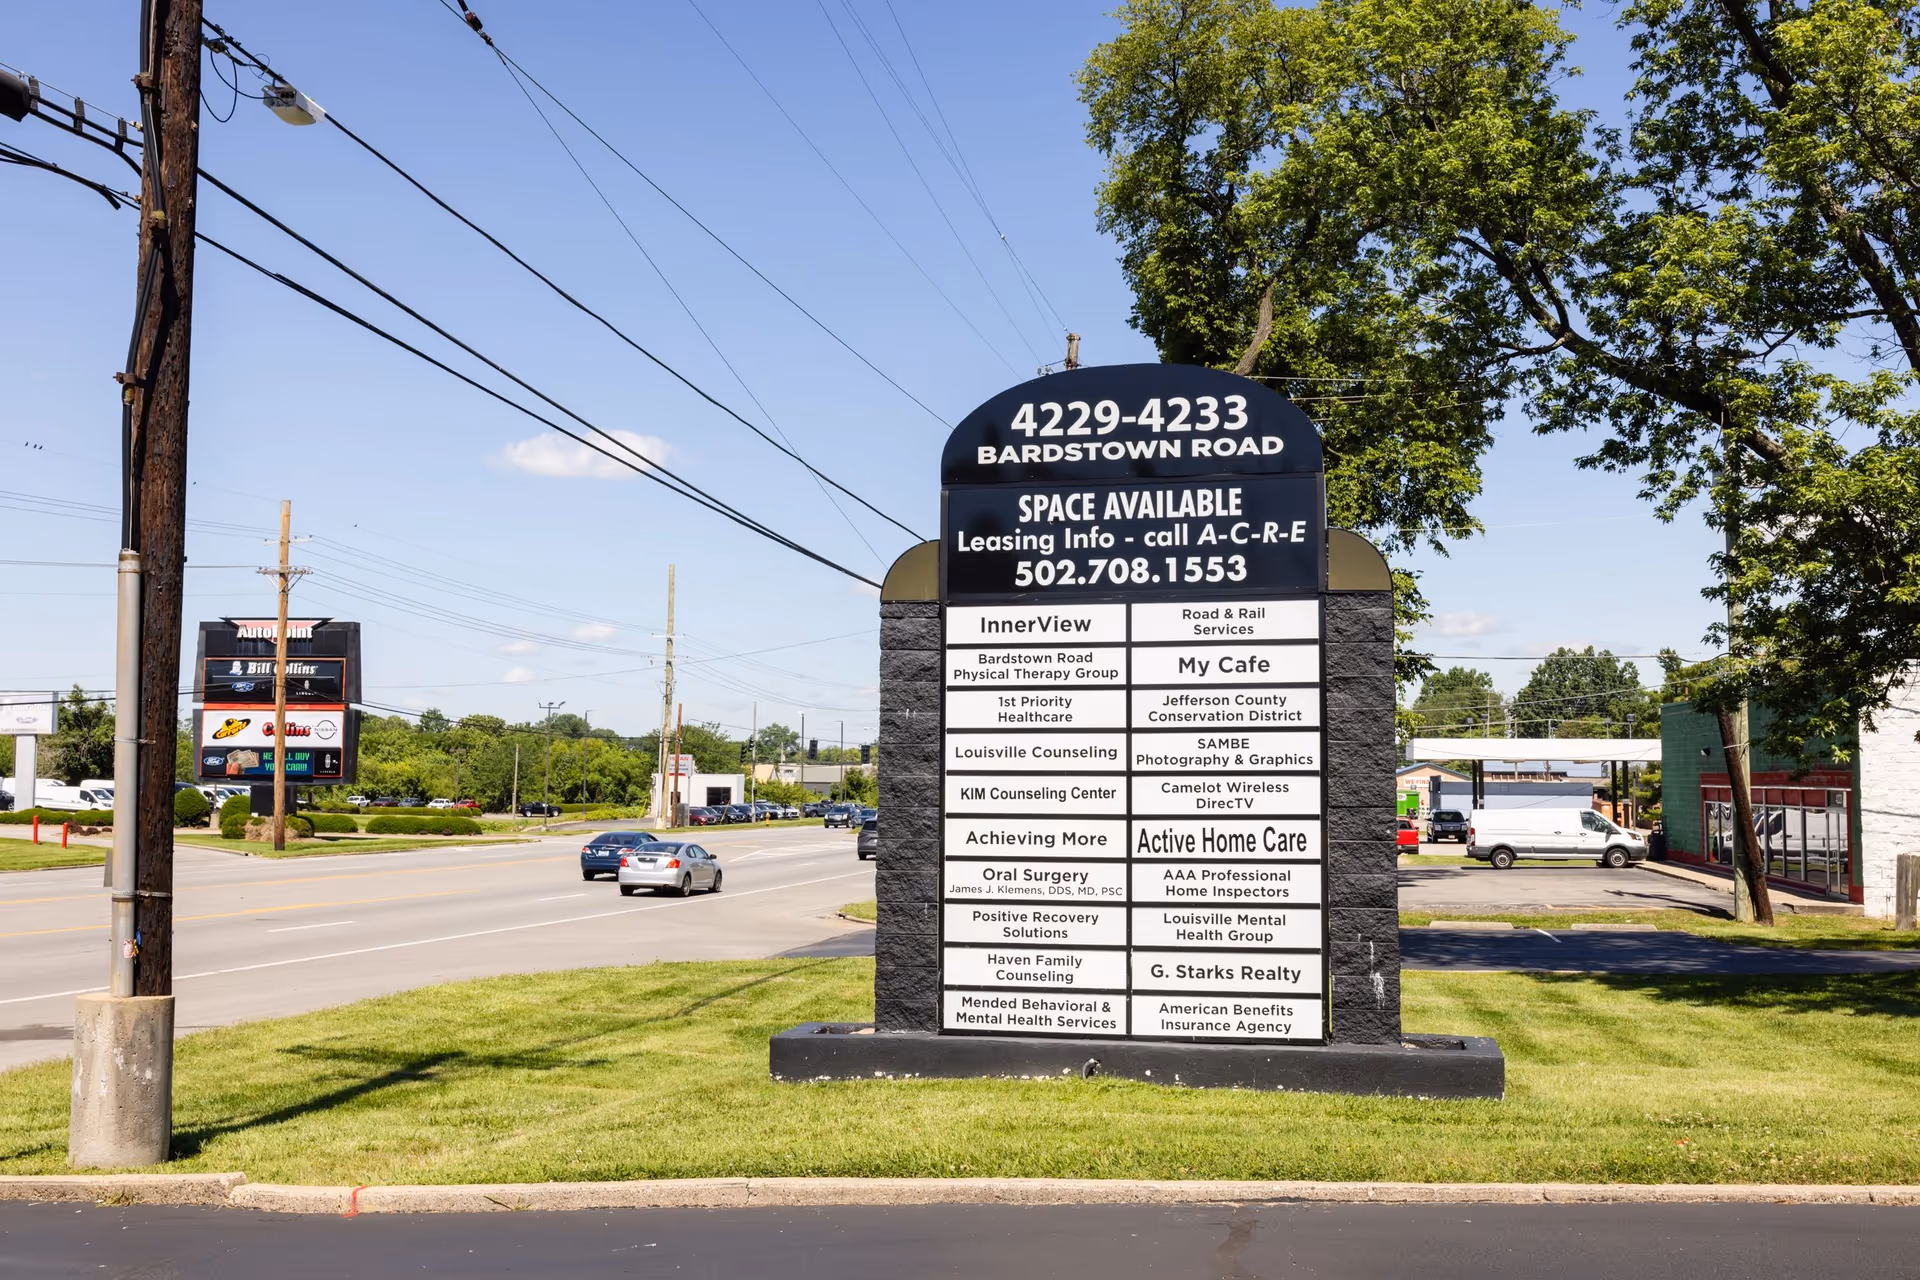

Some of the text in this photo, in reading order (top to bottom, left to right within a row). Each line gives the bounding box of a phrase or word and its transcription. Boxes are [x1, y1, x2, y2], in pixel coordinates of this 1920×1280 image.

[1011, 395, 1247, 436] 4229-4233
[978, 437, 1283, 464] BARDSTOWN ROAD
[1019, 488, 1241, 522] SPACE AVAILABLE
[959, 529, 1054, 555] Leasing
[1066, 526, 1114, 548] Info
[1144, 524, 1187, 546] call
[1197, 521, 1306, 544] A-C-R-E
[1015, 555, 1246, 586] 502.708.1553
[1183, 608, 1264, 619] Road & Rail
[982, 616, 1091, 633] InnerView
[1194, 624, 1254, 635] Services
[979, 652, 1092, 664] Bardstown Road
[247, 662, 271, 675] Bill
[1179, 656, 1270, 677] My Cafe
[954, 668, 1118, 681] Physical Therapy Group
[999, 696, 1072, 708] 1st Priority
[1163, 695, 1286, 707] Jefferson County
[999, 712, 1072, 722] Healthcare
[1149, 710, 1301, 721] Conservation District
[262, 722, 312, 736] Clins
[1198, 739, 1249, 749] SAMBE
[956, 746, 1117, 760] Louisville Counseling
[1137, 754, 1313, 767] Photography & Graphics
[961, 787, 1116, 802] KIM Counseling Center
[1162, 782, 1289, 793] Camelot Wireless
[1197, 798, 1253, 808] DirecTV
[966, 831, 1107, 848] Achieving More
[1137, 826, 1306, 853] Active Home Care
[983, 868, 1088, 884] Oral Surgery
[1164, 870, 1290, 881] AAA Professional
[950, 885, 982, 893] James
[998, 886, 1045, 895] Klemens,
[1049, 887, 1074, 896] DDS,
[1078, 887, 1097, 895] MD,
[1102, 887, 1122, 895] PSC
[1166, 885, 1289, 899] Home Inspectors
[973, 911, 1098, 925] Positive Recovery
[1164, 913, 1285, 925] Louisville Mental
[1003, 927, 1067, 938] Solutions
[1177, 929, 1273, 943] Health Group
[988, 954, 1082, 968] Haven Family
[996, 970, 1073, 984] Counseling
[1151, 964, 1301, 983] G. Starks Realty
[962, 997, 1110, 1012] Mended Behavioral &
[1159, 1003, 1293, 1016] American Benefits
[957, 1012, 1116, 1028] Mental Health Services
[1162, 1019, 1291, 1034] Insurance Agency
